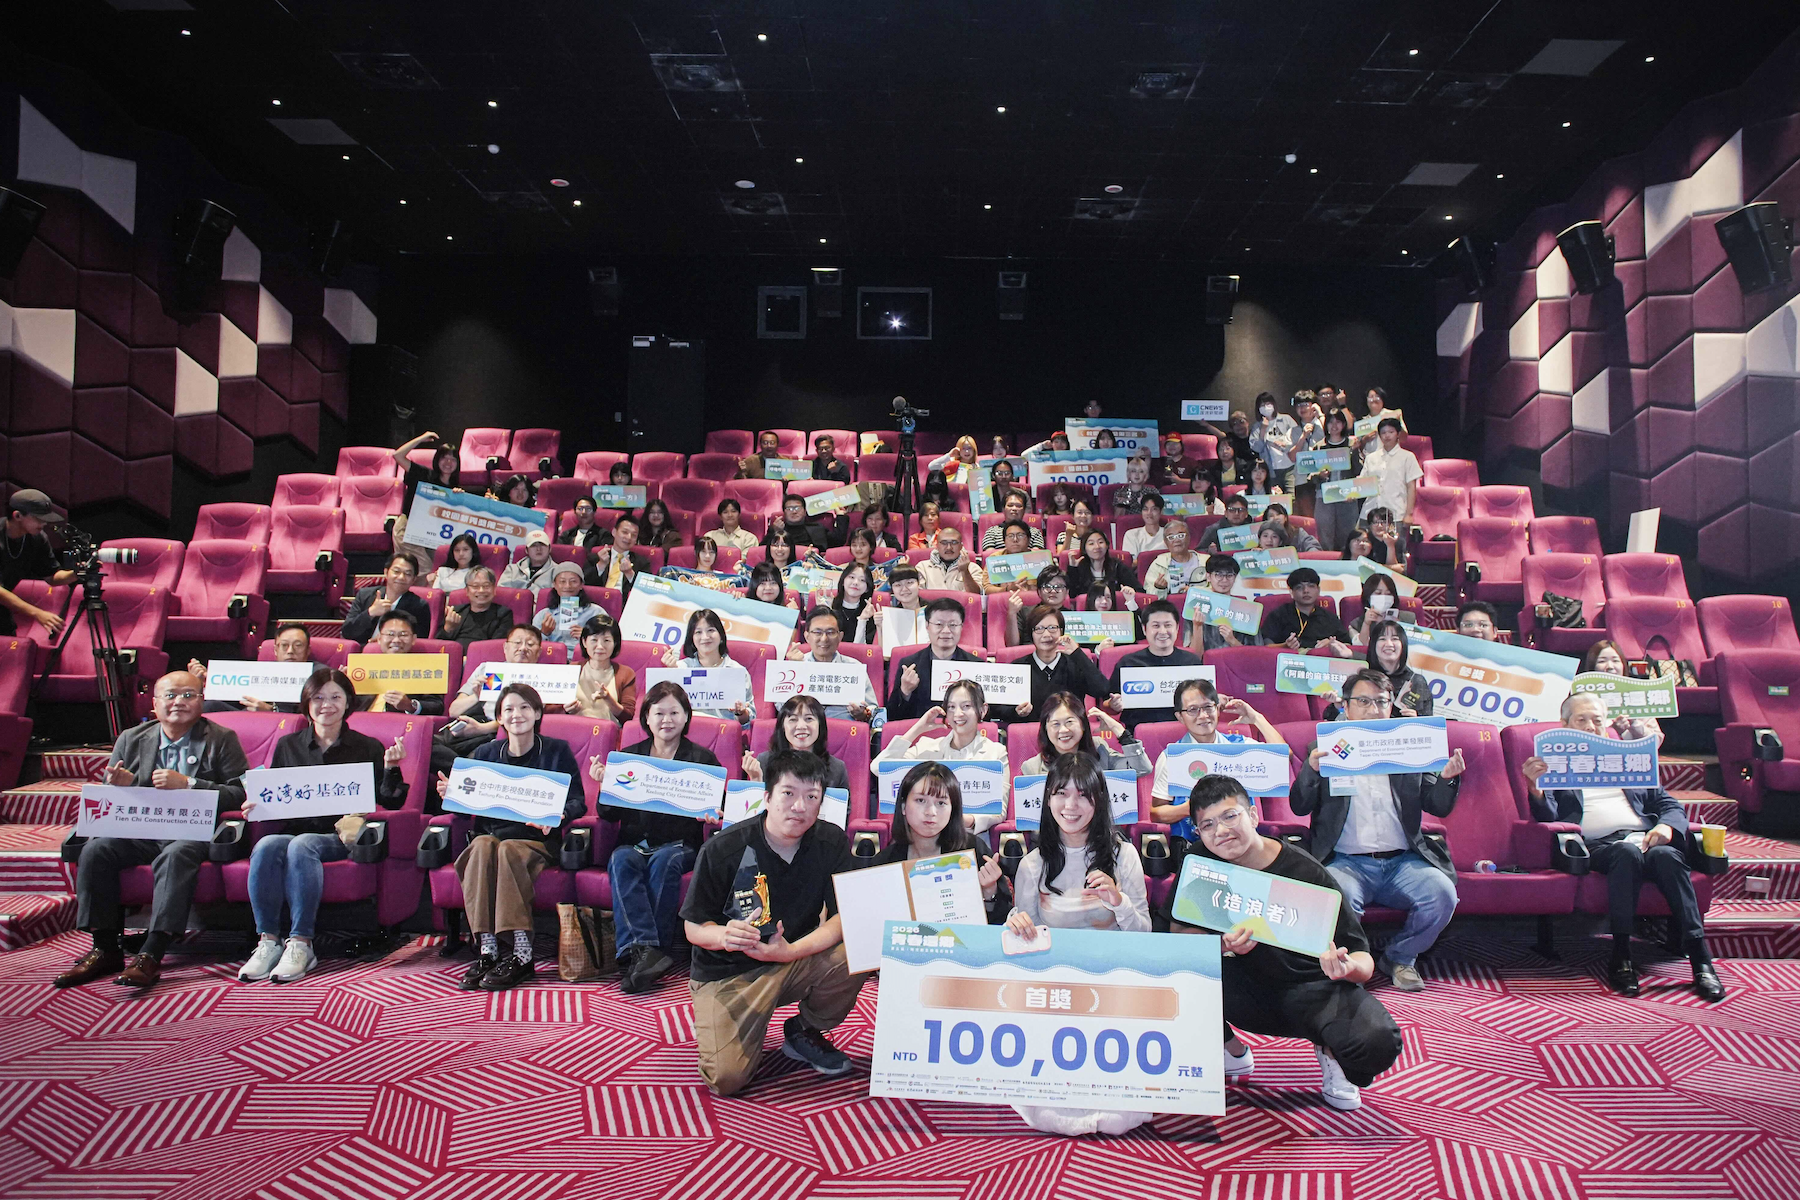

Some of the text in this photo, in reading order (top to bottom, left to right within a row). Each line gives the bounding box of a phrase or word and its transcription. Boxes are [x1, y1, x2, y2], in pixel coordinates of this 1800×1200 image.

[47, 586, 53, 595] 1
[149, 586, 157, 595] 2
[427, 591, 433, 599] 3
[604, 591, 610, 599] 5
[515, 592, 521, 600] 4
[877, 594, 883, 602] 8
[1675, 599, 1687, 608] 15
[1772, 600, 1783, 609] 16
[11, 641, 18, 649] 2
[546, 646, 553, 655] 5
[652, 646, 659, 656] 6
[759, 647, 767, 656] 7
[866, 649, 873, 657] 8
[972, 649, 979, 658] 9
[368, 669, 444, 680] 永慶慈善基金會
[809, 673, 859, 685] 台灣電影文創
[975, 673, 1024, 685] 台灣電影文創
[210, 674, 250, 686] CMG
[808, 684, 841, 693] 產業協會
[979, 684, 1007, 693] 業協會
[1127, 683, 1150, 692] TCA
[1575, 682, 1616, 692] 2026
[279, 719, 285, 729] 4
[406, 722, 413, 732] 5
[720, 723, 726, 733] 7
[593, 726, 599, 735] 6
[851, 726, 857, 735] 8
[979, 729, 987, 738] 9
[1099, 730, 1112, 739] 10
[1480, 731, 1491, 741] 13
[1358, 737, 1432, 748] 臺北市政府產業發展局
[1541, 742, 1589, 753] 2026
[1213, 762, 1267, 774] 新竹縣政府
[1542, 753, 1652, 774] 青春還鄉
[640, 781, 669, 790] Department
[674, 786, 697, 794] Economic
[960, 780, 991, 790] 青年局
[479, 781, 556, 800] 台中市影視發展基金會
[645, 789, 666, 797] Keelung
[676, 793, 706, 802] Government
[478, 790, 495, 799] Taichung
[504, 795, 531, 803] Development
[531, 798, 553, 807] Foundation
[144, 817, 188, 825] Construction
[189, 818, 214, 826] Co.Ltd.
[1211, 888, 1299, 928] 《造浪者》
[892, 926, 920, 934] 2026
[1025, 986, 1072, 1011] 首獎
[923, 1018, 1173, 1078] 100,000
[892, 1051, 918, 1062] NTD
[1177, 1065, 1204, 1078] 元整
